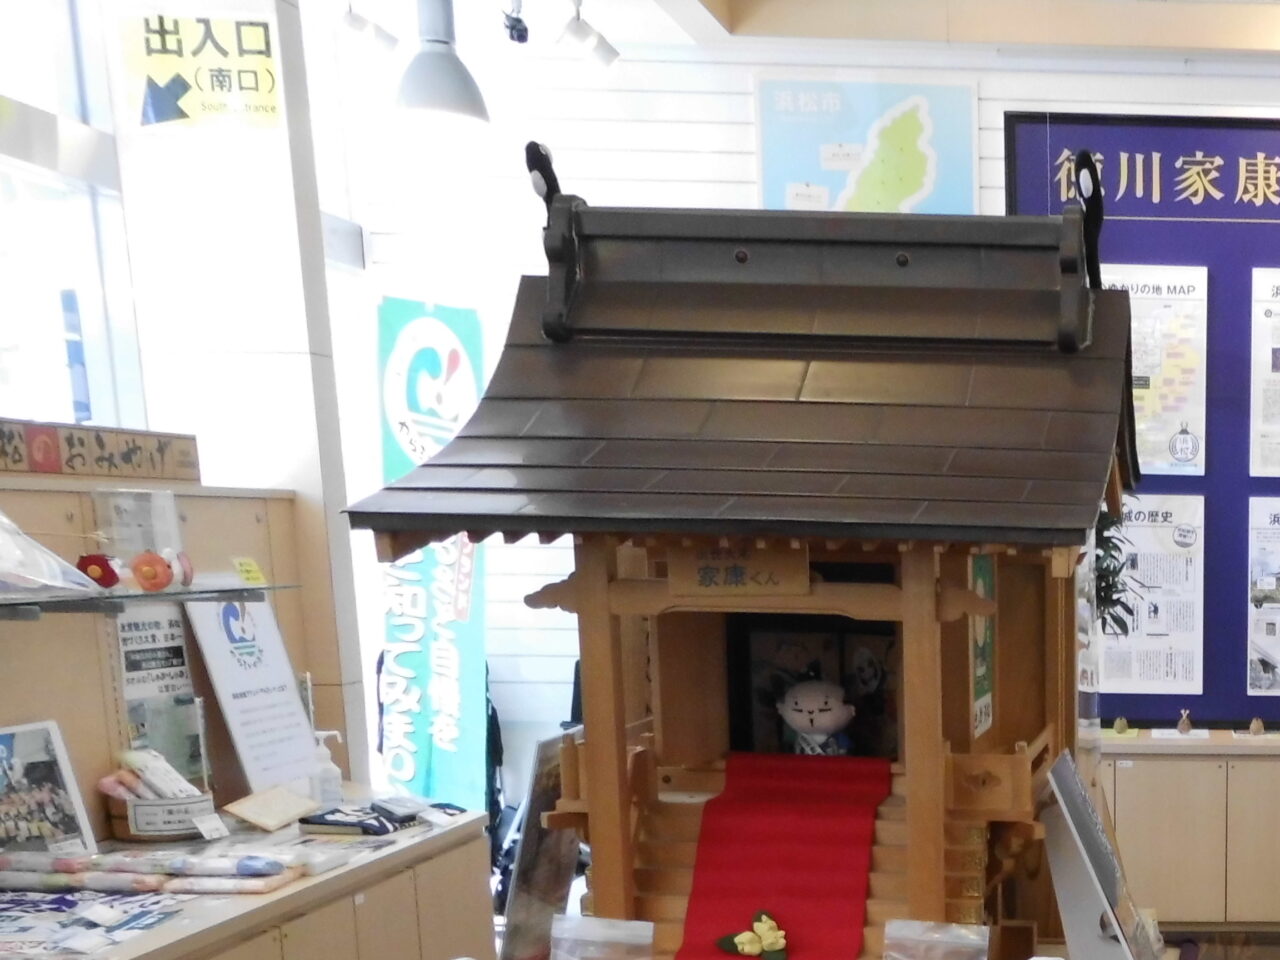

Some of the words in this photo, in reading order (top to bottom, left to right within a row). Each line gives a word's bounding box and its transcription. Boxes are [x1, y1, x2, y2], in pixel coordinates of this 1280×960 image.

[144, 15, 272, 58] 出入口
[1166, 285, 1195, 296] MAP
[697, 563, 780, 587] 家康くん
